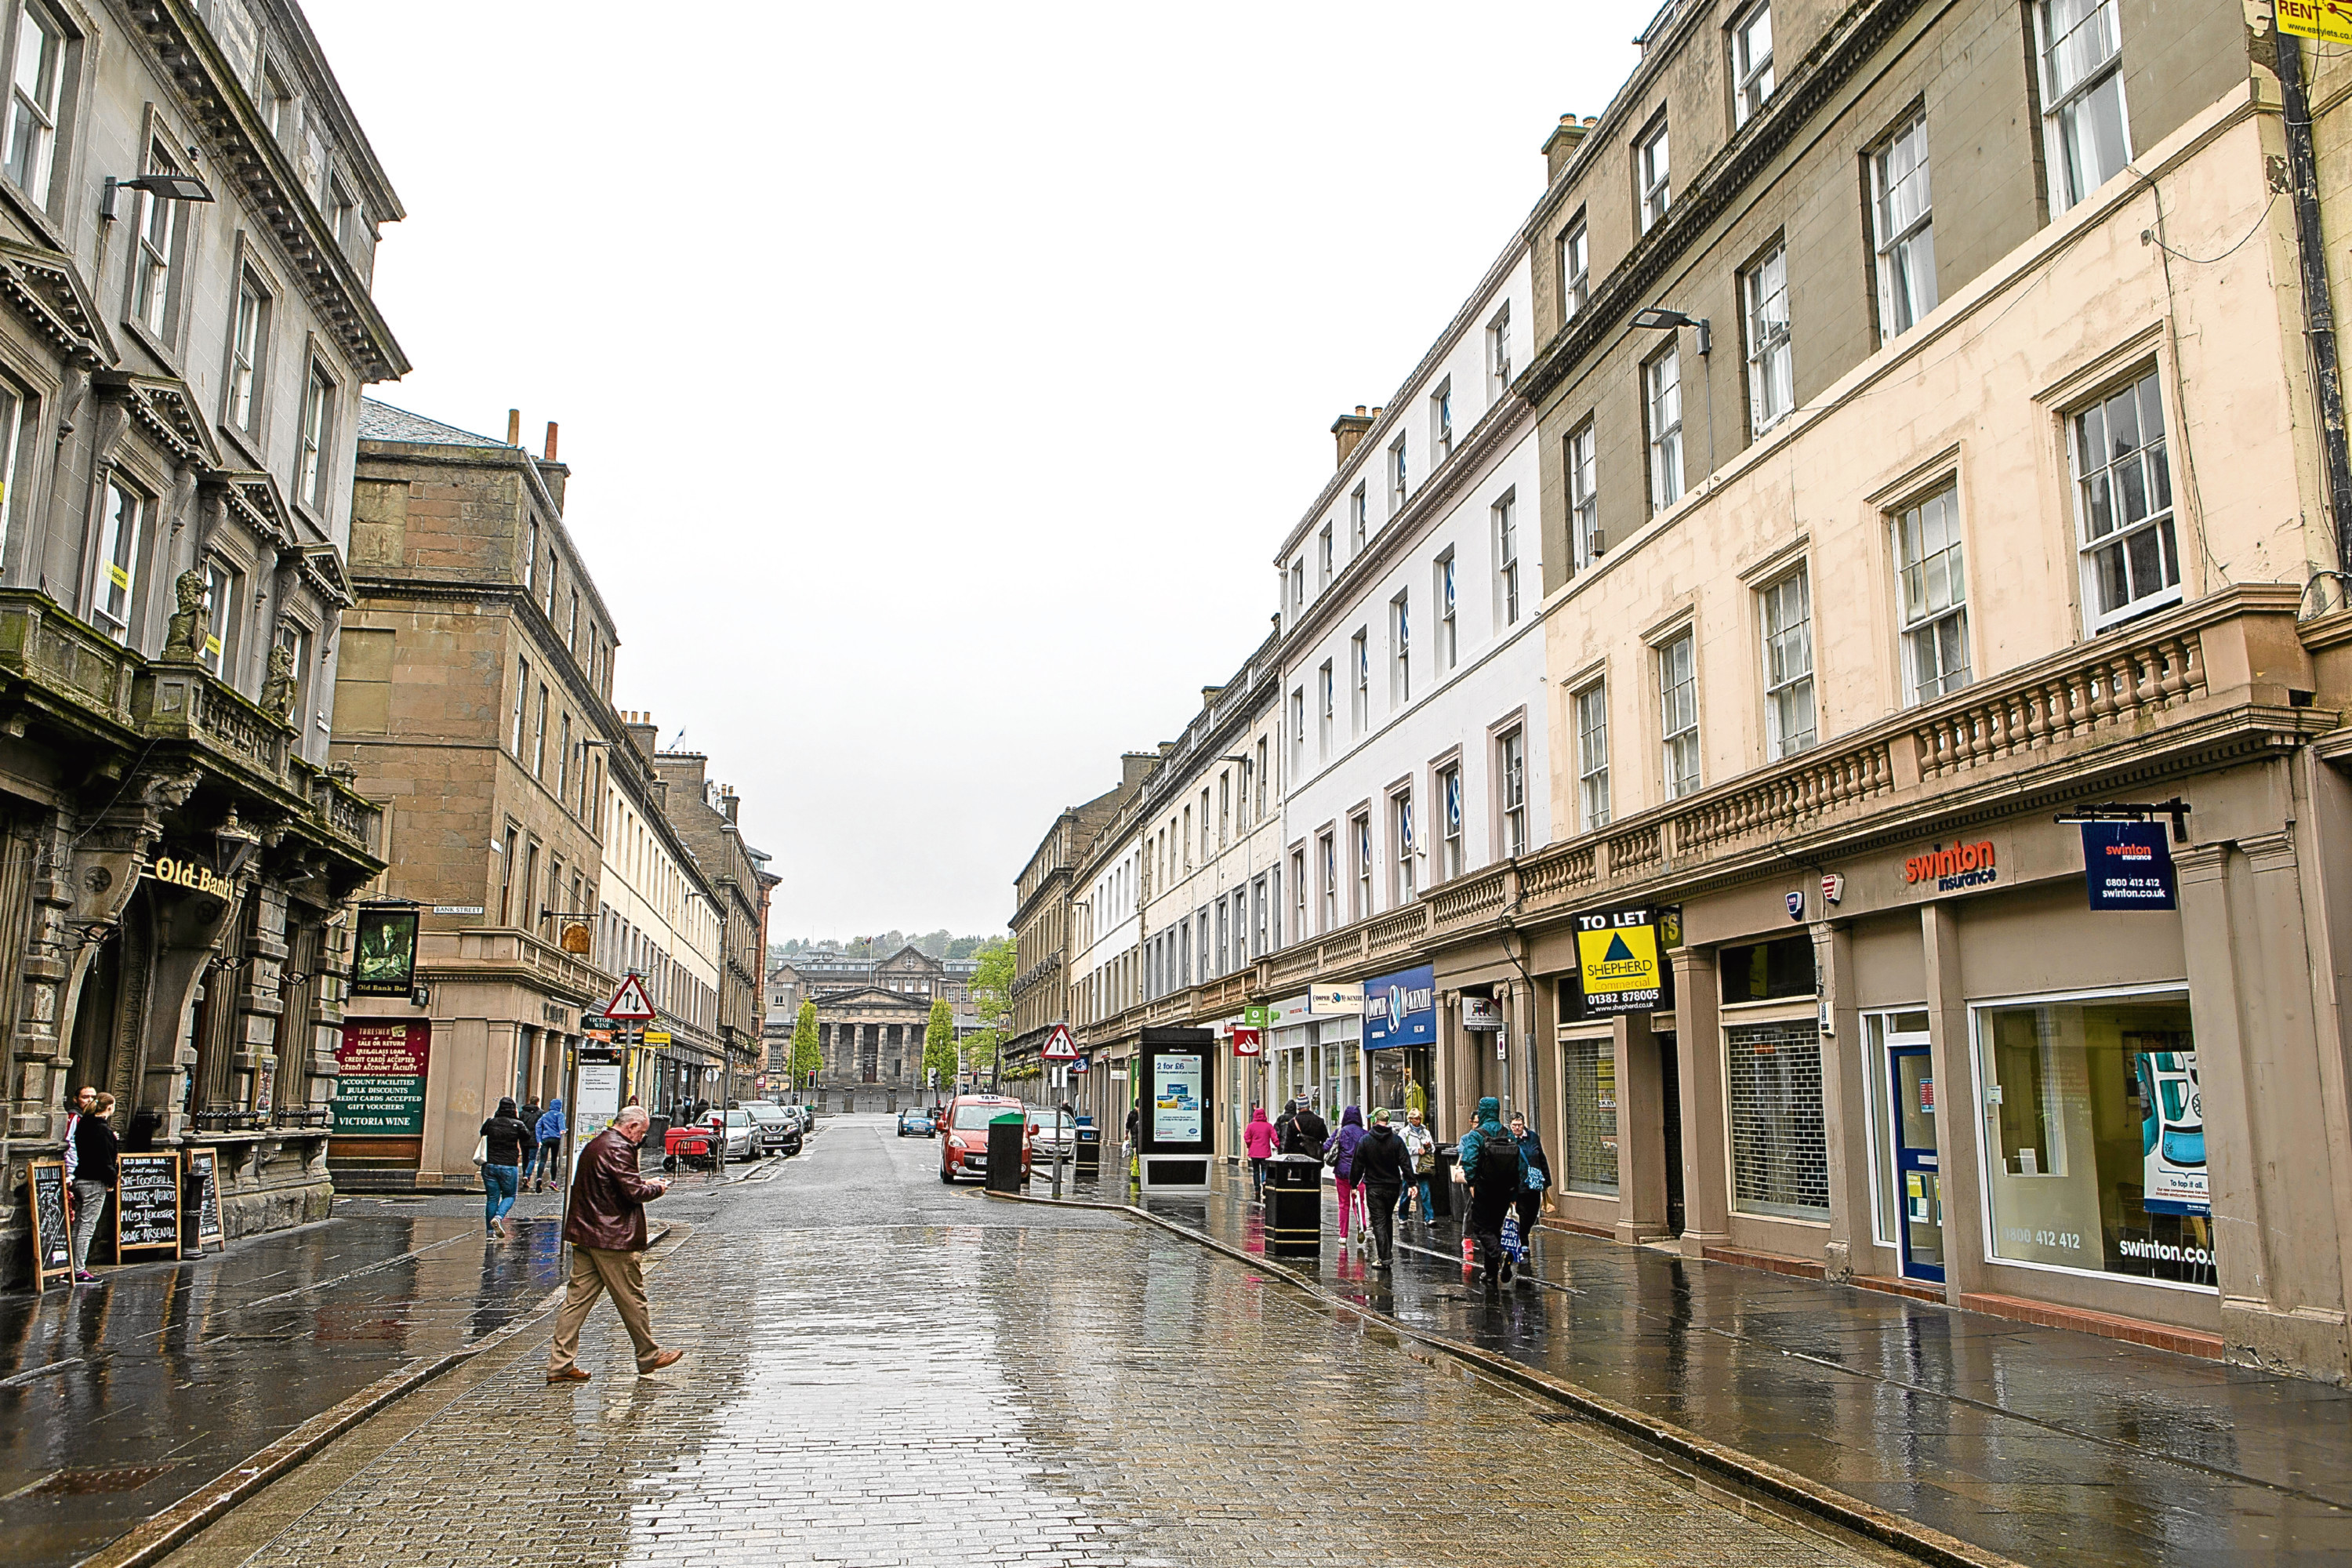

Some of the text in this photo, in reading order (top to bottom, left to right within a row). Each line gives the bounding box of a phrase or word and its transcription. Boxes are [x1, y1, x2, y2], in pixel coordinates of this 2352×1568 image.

[2106, 843, 2151, 855] swinton
[1905, 840, 1995, 883] swinton
[156, 857, 194, 887] Old
[198, 867, 230, 899] Bank
[1939, 869, 1996, 891] insurance
[2102, 888, 2165, 898] swinton.co.uk
[1579, 910, 1646, 930] TO LET
[1588, 960, 1653, 976] SHEPHERD
[1595, 977, 1650, 991] Commercial
[1588, 989, 1659, 1004] 01382 878005
[1366, 994, 1387, 1024] COOPER
[1595, 1001, 1653, 1012] www.shepherd.co.uk
[2178, 1180, 2187, 1189] top
[122, 1192, 149, 1201] RANGERS
[144, 1209, 175, 1221] LEICESTER
[121, 1227, 176, 1243] STOKE ARSENAL
[2003, 1227, 2080, 1249] 0800 412 412
